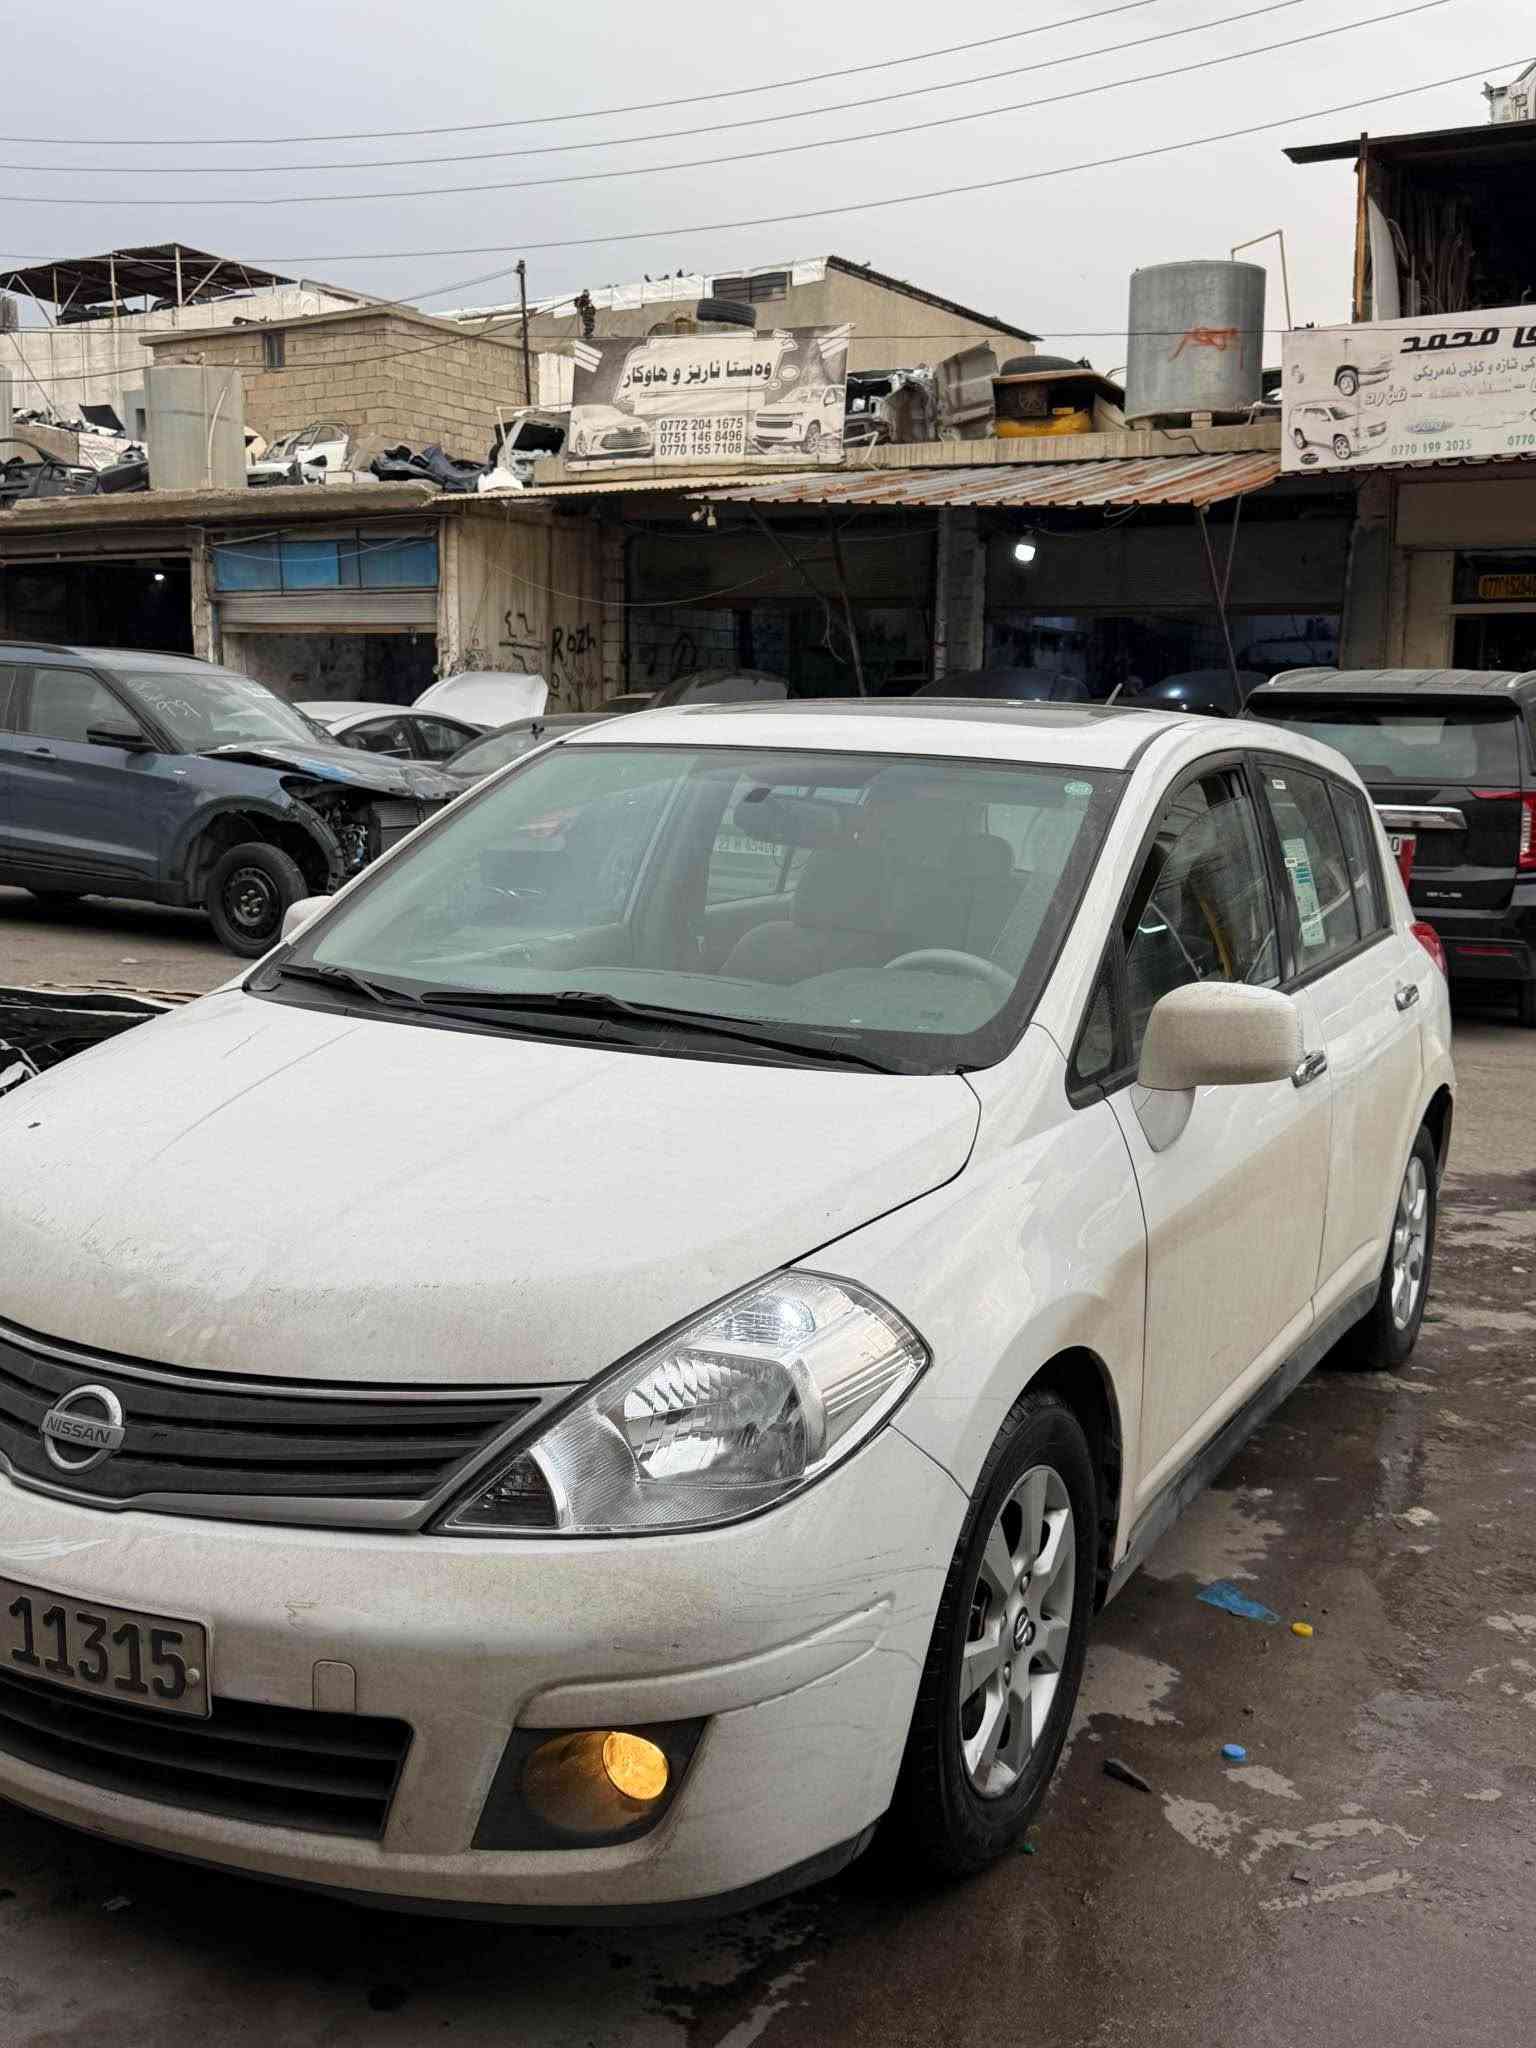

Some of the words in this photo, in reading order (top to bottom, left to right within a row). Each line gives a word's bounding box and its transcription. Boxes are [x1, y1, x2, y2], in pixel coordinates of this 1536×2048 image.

[1399, 327, 1500, 354] محمد
[660, 419, 688, 432] 0772
[691, 418, 712, 431] 204
[716, 416, 744, 430] 1675
[660, 431, 687, 444] 0751
[691, 430, 712, 443] 146
[660, 443, 687, 456] 0770
[691, 442, 711, 455] 155
[713, 442, 742, 454] 7108
[46, 1415, 111, 1445] NISSAN
[8, 1595, 188, 1700] 11315
